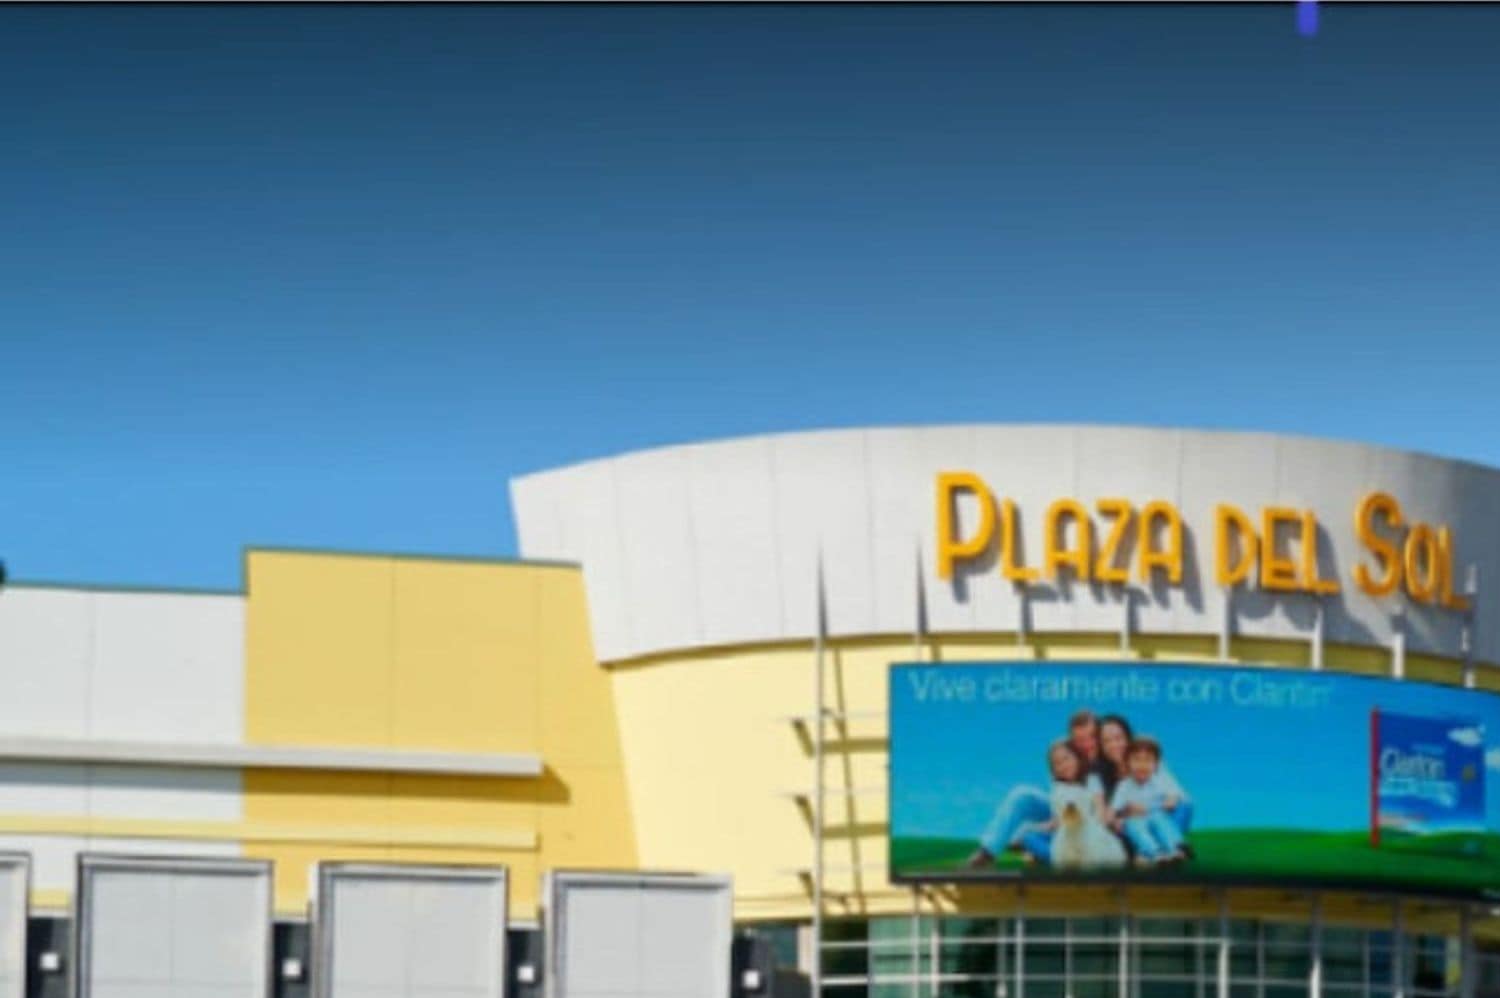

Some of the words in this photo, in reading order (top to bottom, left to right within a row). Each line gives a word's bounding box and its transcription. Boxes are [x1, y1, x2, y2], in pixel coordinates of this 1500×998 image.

[936, 472, 1183, 584] PLAZA
[1214, 505, 1339, 594] DEL
[909, 671, 976, 700] Vive
[983, 671, 1156, 702] claramente
[1168, 677, 1222, 702] con
